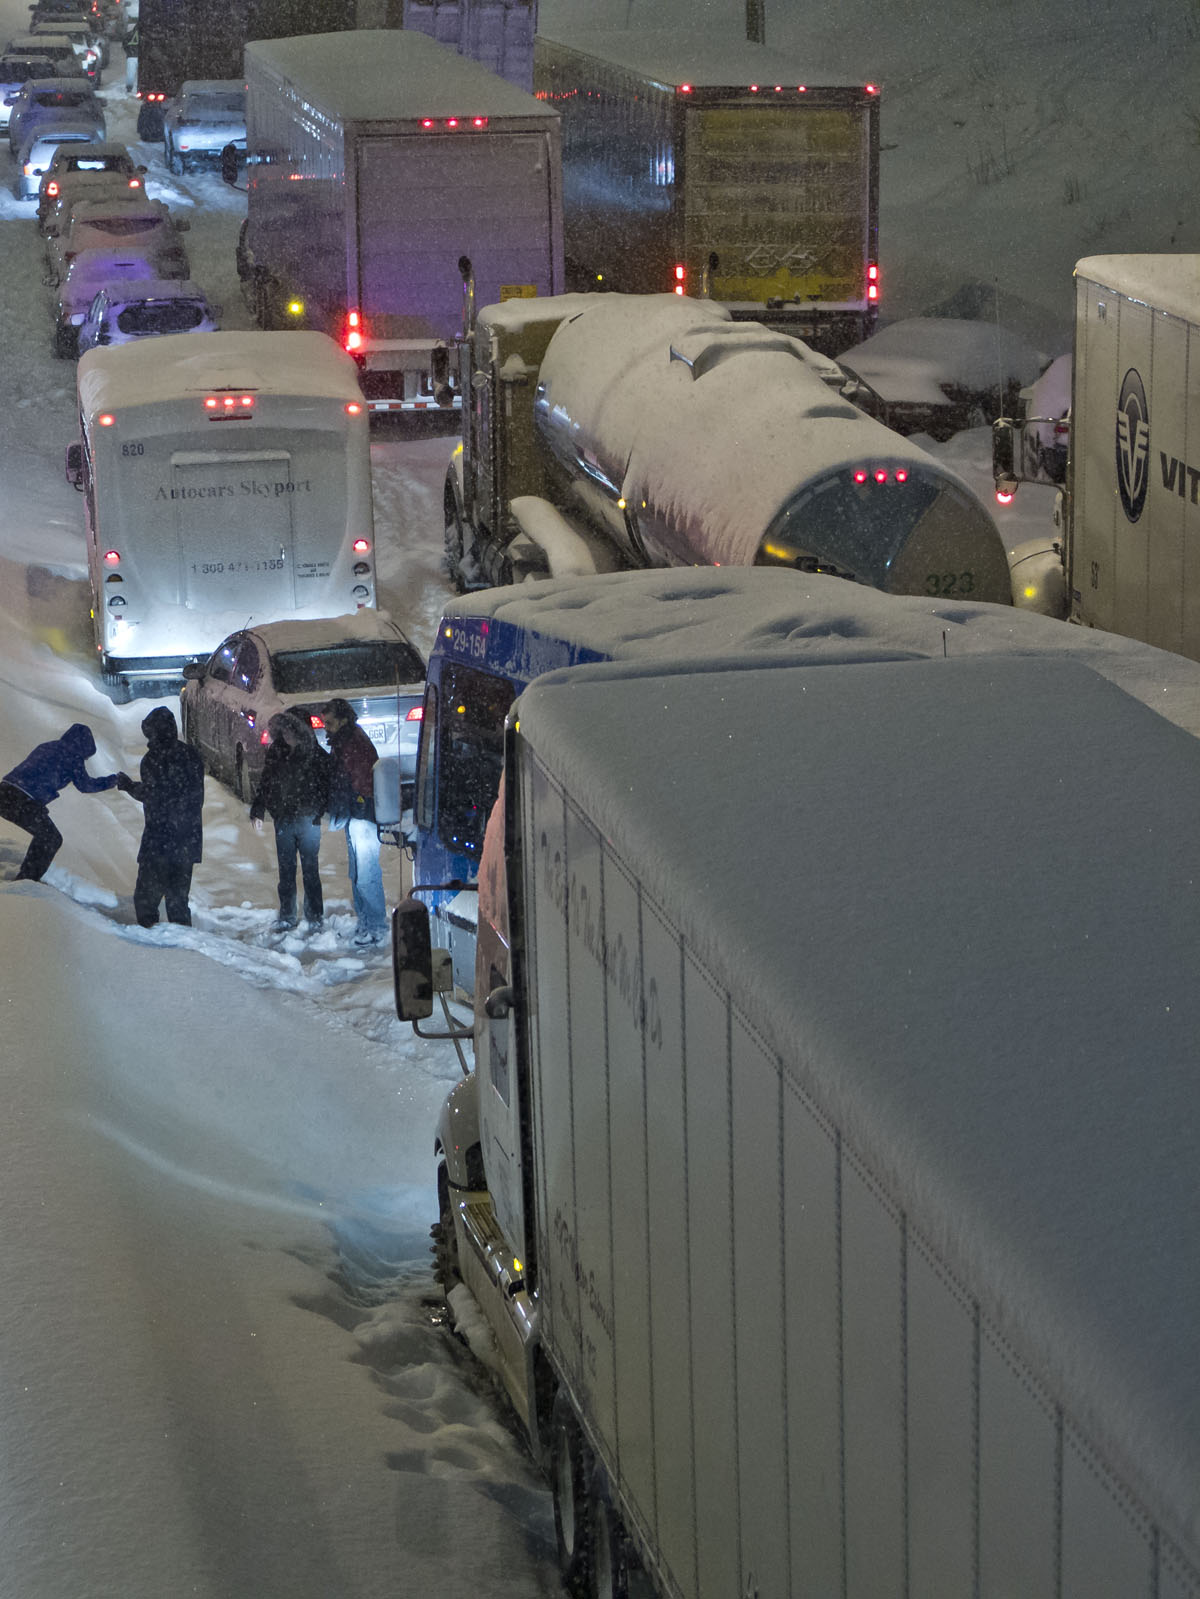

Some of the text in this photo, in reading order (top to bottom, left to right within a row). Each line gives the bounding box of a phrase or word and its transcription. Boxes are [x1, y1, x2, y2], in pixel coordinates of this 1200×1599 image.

[121, 443, 145, 457] 820
[155, 478, 312, 501] Autocars Skyport
[1159, 449, 1200, 505] VIT
[925, 571, 975, 596] 323
[453, 628, 487, 659] 29-154
